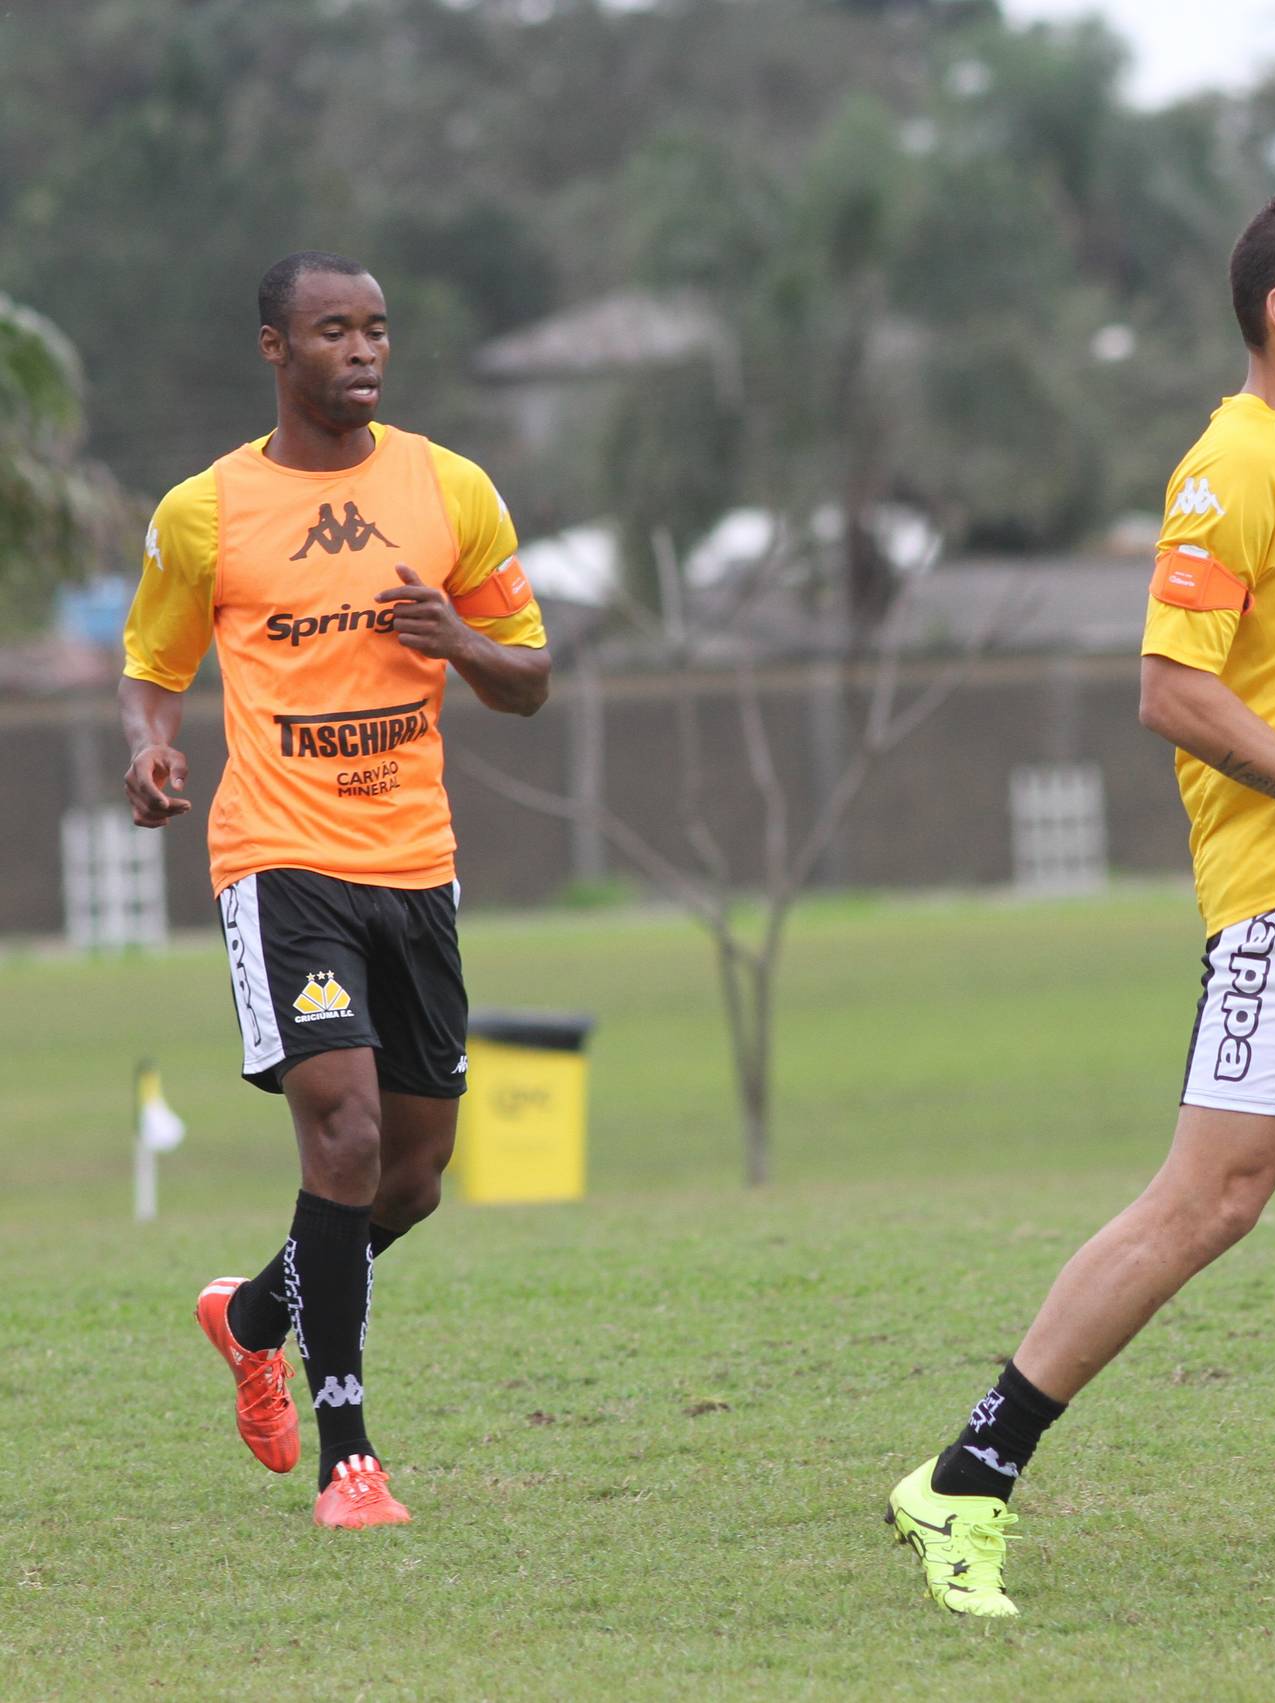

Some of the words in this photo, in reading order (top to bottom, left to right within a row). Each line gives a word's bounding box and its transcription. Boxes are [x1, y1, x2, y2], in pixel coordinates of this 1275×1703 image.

[273, 698, 430, 758] TASCHIBRA
[336, 761, 399, 786] CARVÃO
[337, 777, 401, 798] MINERAL
